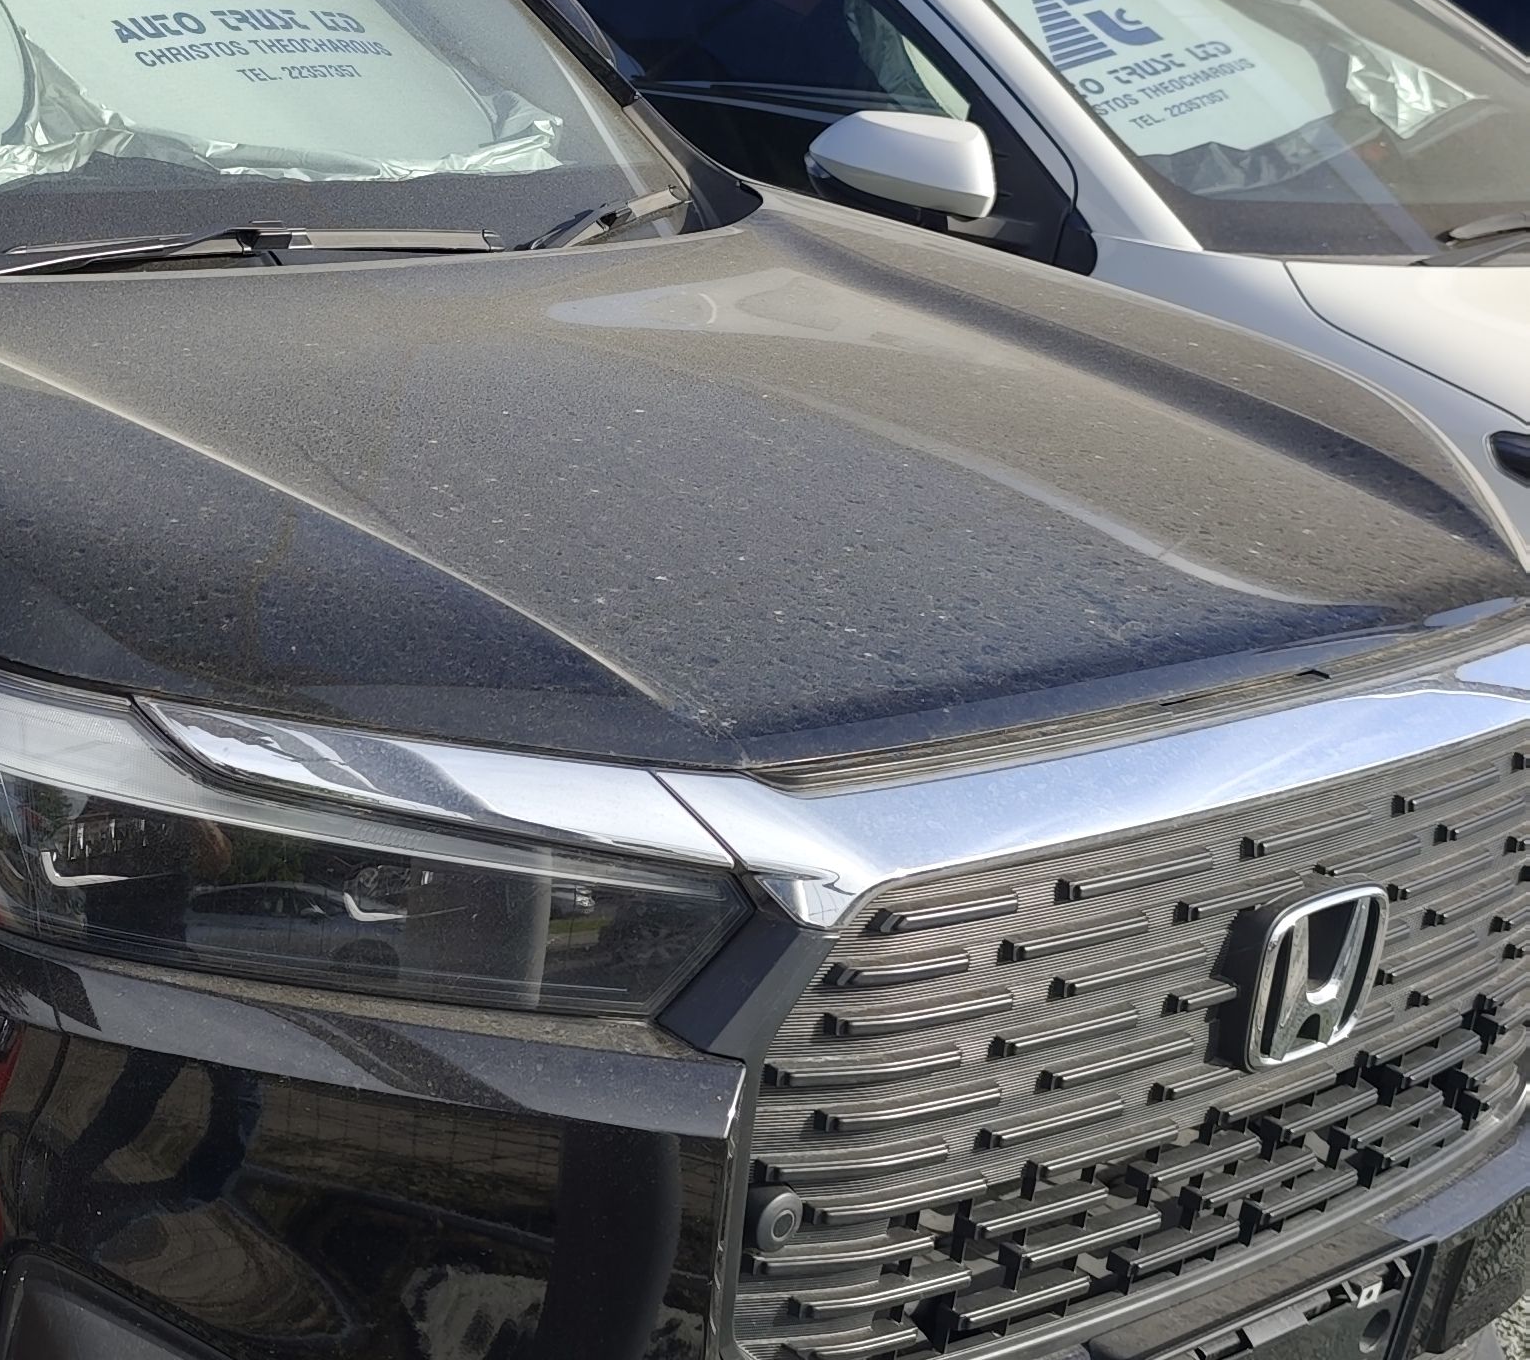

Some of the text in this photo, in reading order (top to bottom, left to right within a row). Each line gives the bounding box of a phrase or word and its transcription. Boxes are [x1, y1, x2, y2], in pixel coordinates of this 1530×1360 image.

[110, 8, 366, 43] AUTO TRUST LTD
[135, 38, 393, 67] CHRISTOS THEOCHAROUS
[1107, 40, 1233, 85] TRUST LTD
[237, 64, 362, 83] TEL. 22357357
[1091, 93, 1140, 116] STOS
[1137, 57, 1256, 99] THEOCHAROUS
[1128, 89, 1230, 129] TEL. 22357357
